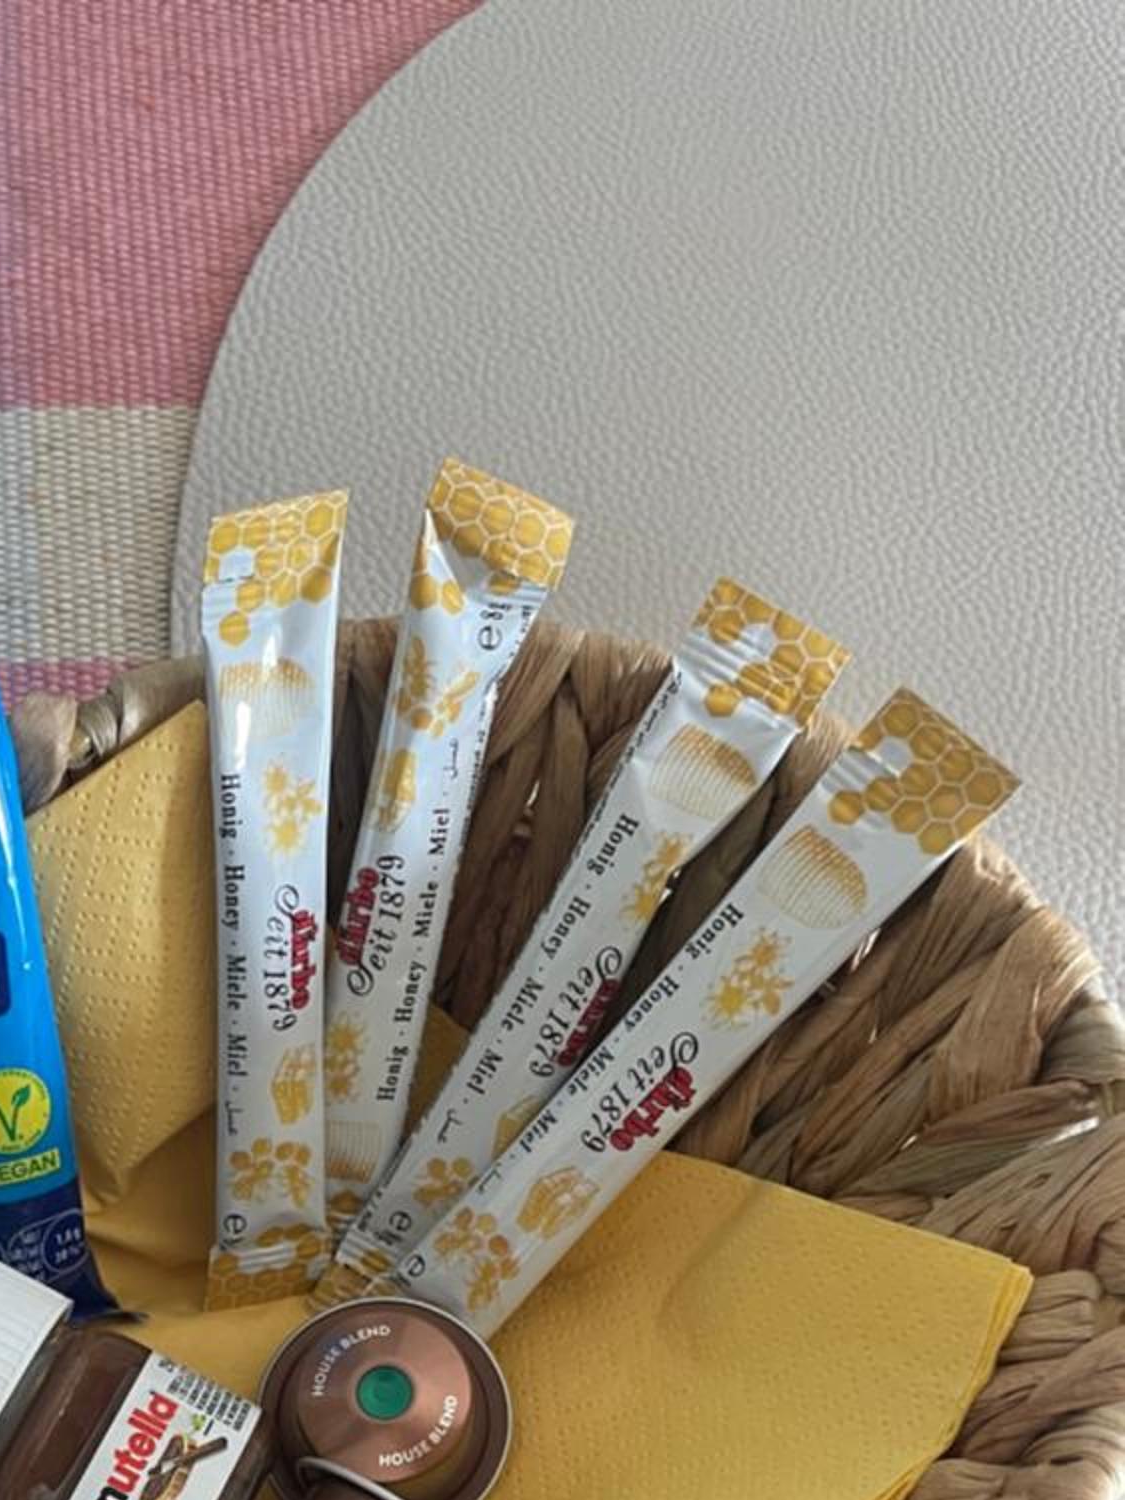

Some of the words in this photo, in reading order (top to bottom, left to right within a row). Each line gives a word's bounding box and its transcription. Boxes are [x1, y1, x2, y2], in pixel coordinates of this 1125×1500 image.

[219, 772, 244, 840] Honig
[429, 807, 451, 856] Miel
[588, 813, 641, 880] Honig
[222, 866, 246, 930] Honey
[378, 854, 406, 926] 1879
[413, 882, 439, 938] Miele
[544, 895, 592, 960] Honey
[687, 901, 745, 962] Honig
[226, 953, 248, 1010] Miele
[263, 968, 297, 1032] 1879
[393, 960, 429, 1023] Honey
[500, 976, 545, 1033] Miele
[622, 975, 681, 1033] Honey
[225, 1032, 249, 1077] Miel
[377, 1044, 411, 1102] Honig
[465, 1049, 505, 1097] Miel
[530, 1004, 571, 1080] 1879
[566, 1046, 616, 1097] Miele
[519, 1111, 560, 1156] Miel
[579, 1077, 632, 1154] 1879
[311, 1346, 341, 1396] HOUSE
[339, 1325, 391, 1349] BLEND
[379, 1439, 431, 1467] HOUSE
[428, 1394, 458, 1444] BLEND
